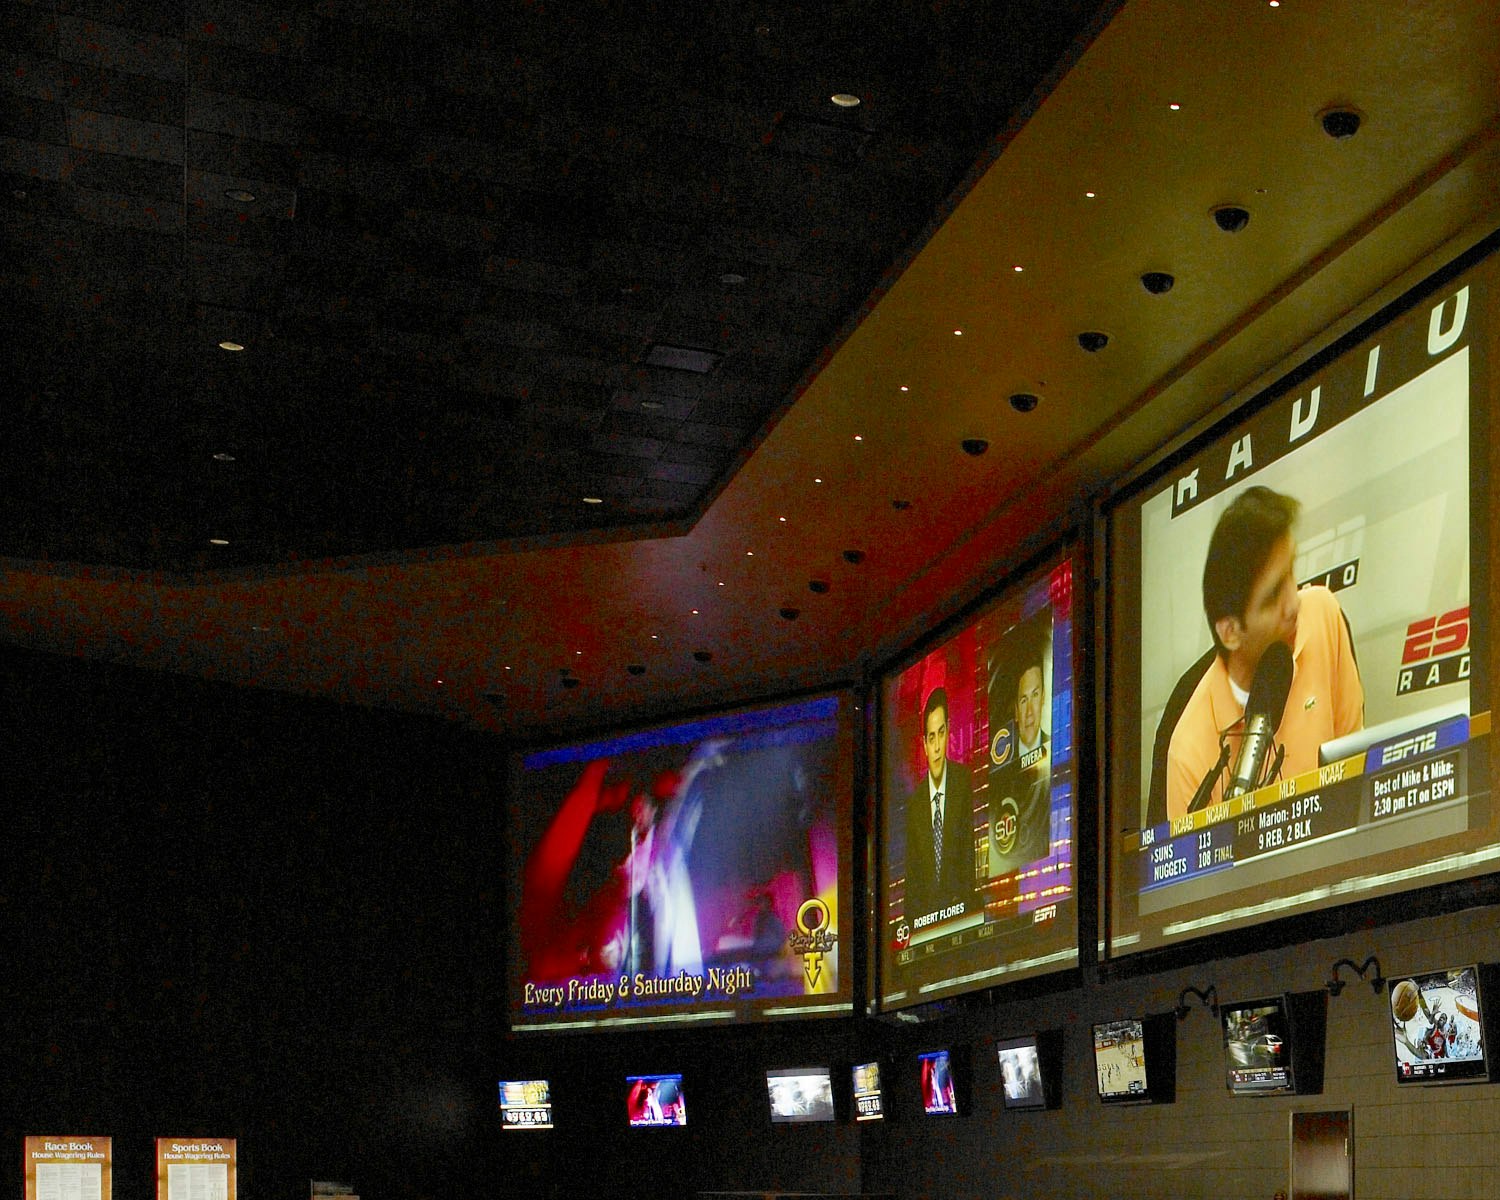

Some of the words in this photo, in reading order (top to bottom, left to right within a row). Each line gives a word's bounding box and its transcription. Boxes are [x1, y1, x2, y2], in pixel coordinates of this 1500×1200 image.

[1020, 748, 1043, 769] RIVERA
[1381, 731, 1438, 766] ESPN2
[1374, 780, 1392, 797] Best
[1392, 776, 1400, 791] of
[1401, 769, 1421, 787] Mike
[1422, 766, 1430, 782] &
[1430, 761, 1454, 779] Mike:
[1142, 828, 1155, 847] NBA
[1173, 816, 1194, 835] NCAAB
[1205, 804, 1231, 824] NCAAW
[1241, 796, 1256, 813] NHL
[1279, 780, 1297, 800] MLB
[1319, 763, 1347, 787] NCAAF
[1373, 799, 1392, 818] 2:30
[1392, 797, 1406, 814] pm
[1407, 790, 1418, 807] ET
[1418, 789, 1430, 804] on
[1431, 778, 1455, 800] ESPN
[995, 815, 1017, 841] SC
[1238, 817, 1255, 835] PHX
[1258, 809, 1289, 830] Marion:
[1291, 801, 1302, 819] 19
[1154, 843, 1174, 863] SUNS
[1198, 832, 1212, 850] 113
[1258, 835, 1264, 850] 9
[1265, 829, 1285, 848] REB,
[1286, 827, 1293, 842] 2
[1294, 821, 1312, 839] BLK
[1153, 858, 1187, 881] NUGGETS
[1198, 851, 1212, 869] 108
[1214, 844, 1234, 863] FINAL
[913, 910, 939, 929] ROBERT
[939, 902, 965, 921] FLORES
[1034, 904, 1057, 923] ESPN
[896, 925, 910, 943] SC
[524, 983, 564, 1006] Every
[568, 978, 615, 1003] Friday
[618, 975, 630, 998] &
[634, 968, 703, 996] Saturday
[706, 966, 751, 995] Night
[44, 1142, 67, 1151] Race
[69, 1142, 93, 1151] Book
[54, 1152, 87, 1161] Wagering
[172, 1143, 200, 1153] Sports
[201, 1144, 223, 1152] Book
[184, 1153, 214, 1161] Wagering
